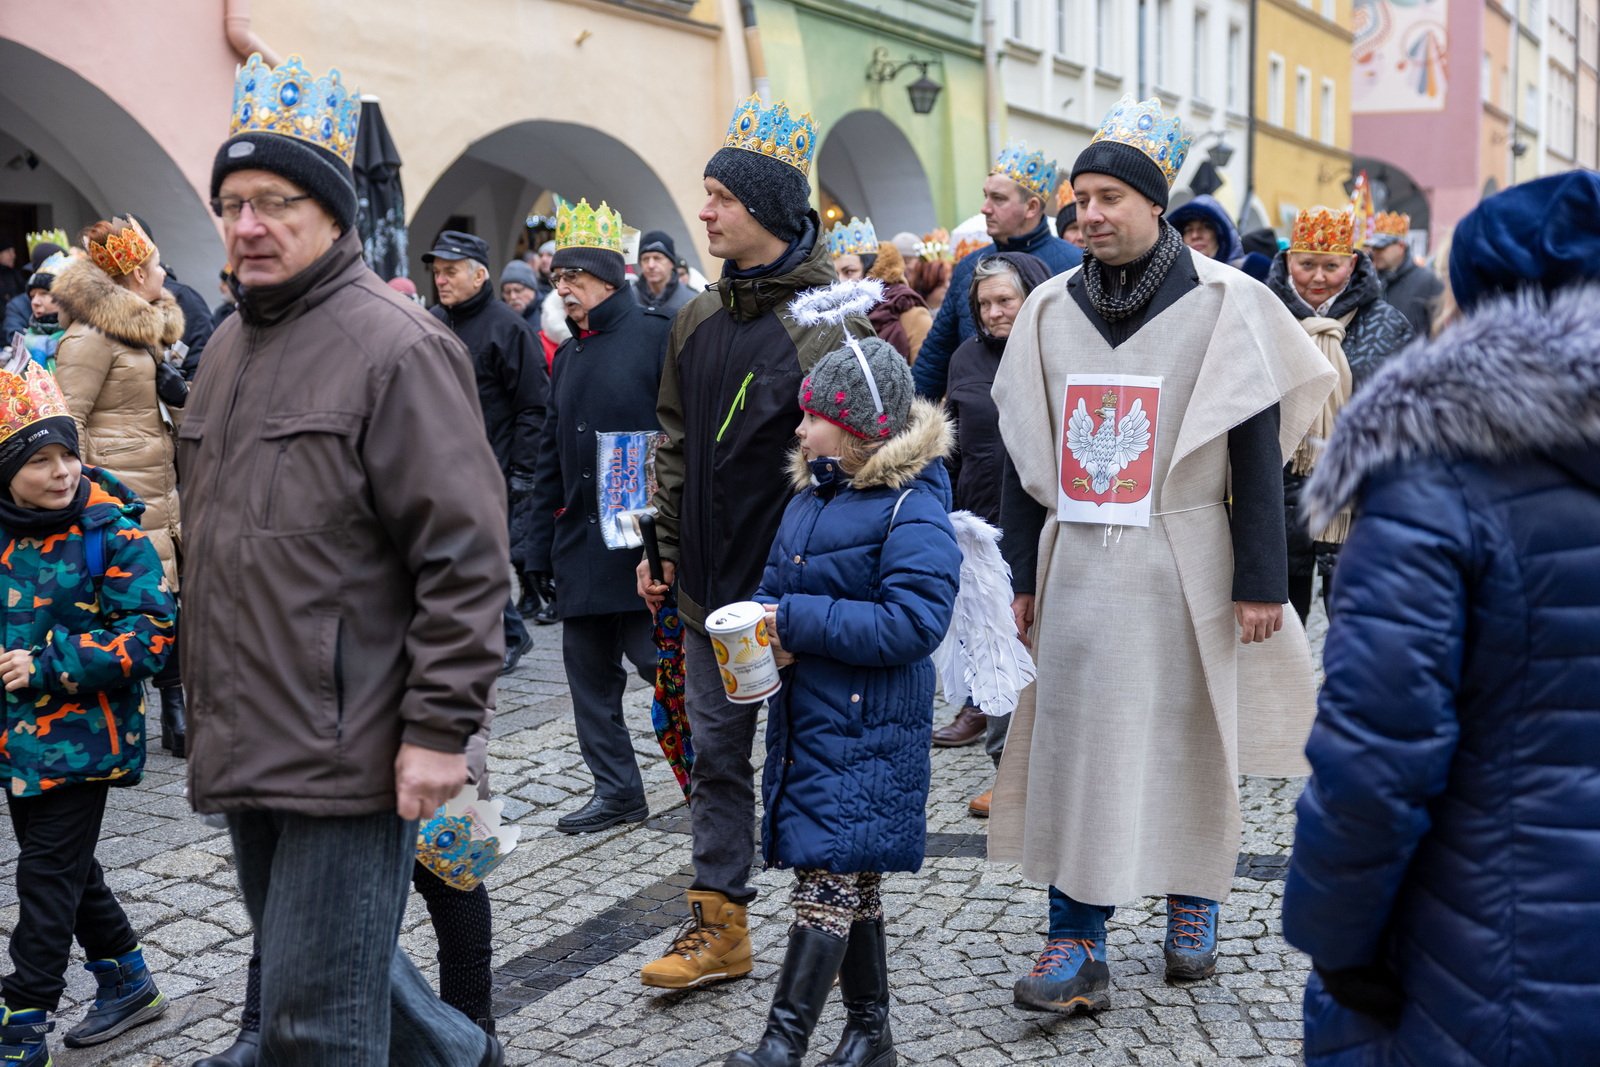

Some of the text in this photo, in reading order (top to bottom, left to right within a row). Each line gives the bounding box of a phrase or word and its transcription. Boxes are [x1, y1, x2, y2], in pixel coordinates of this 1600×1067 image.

[29, 429, 49, 442] KIPSTA
[608, 447, 627, 512] Jelenia
[624, 447, 639, 493] Góra
